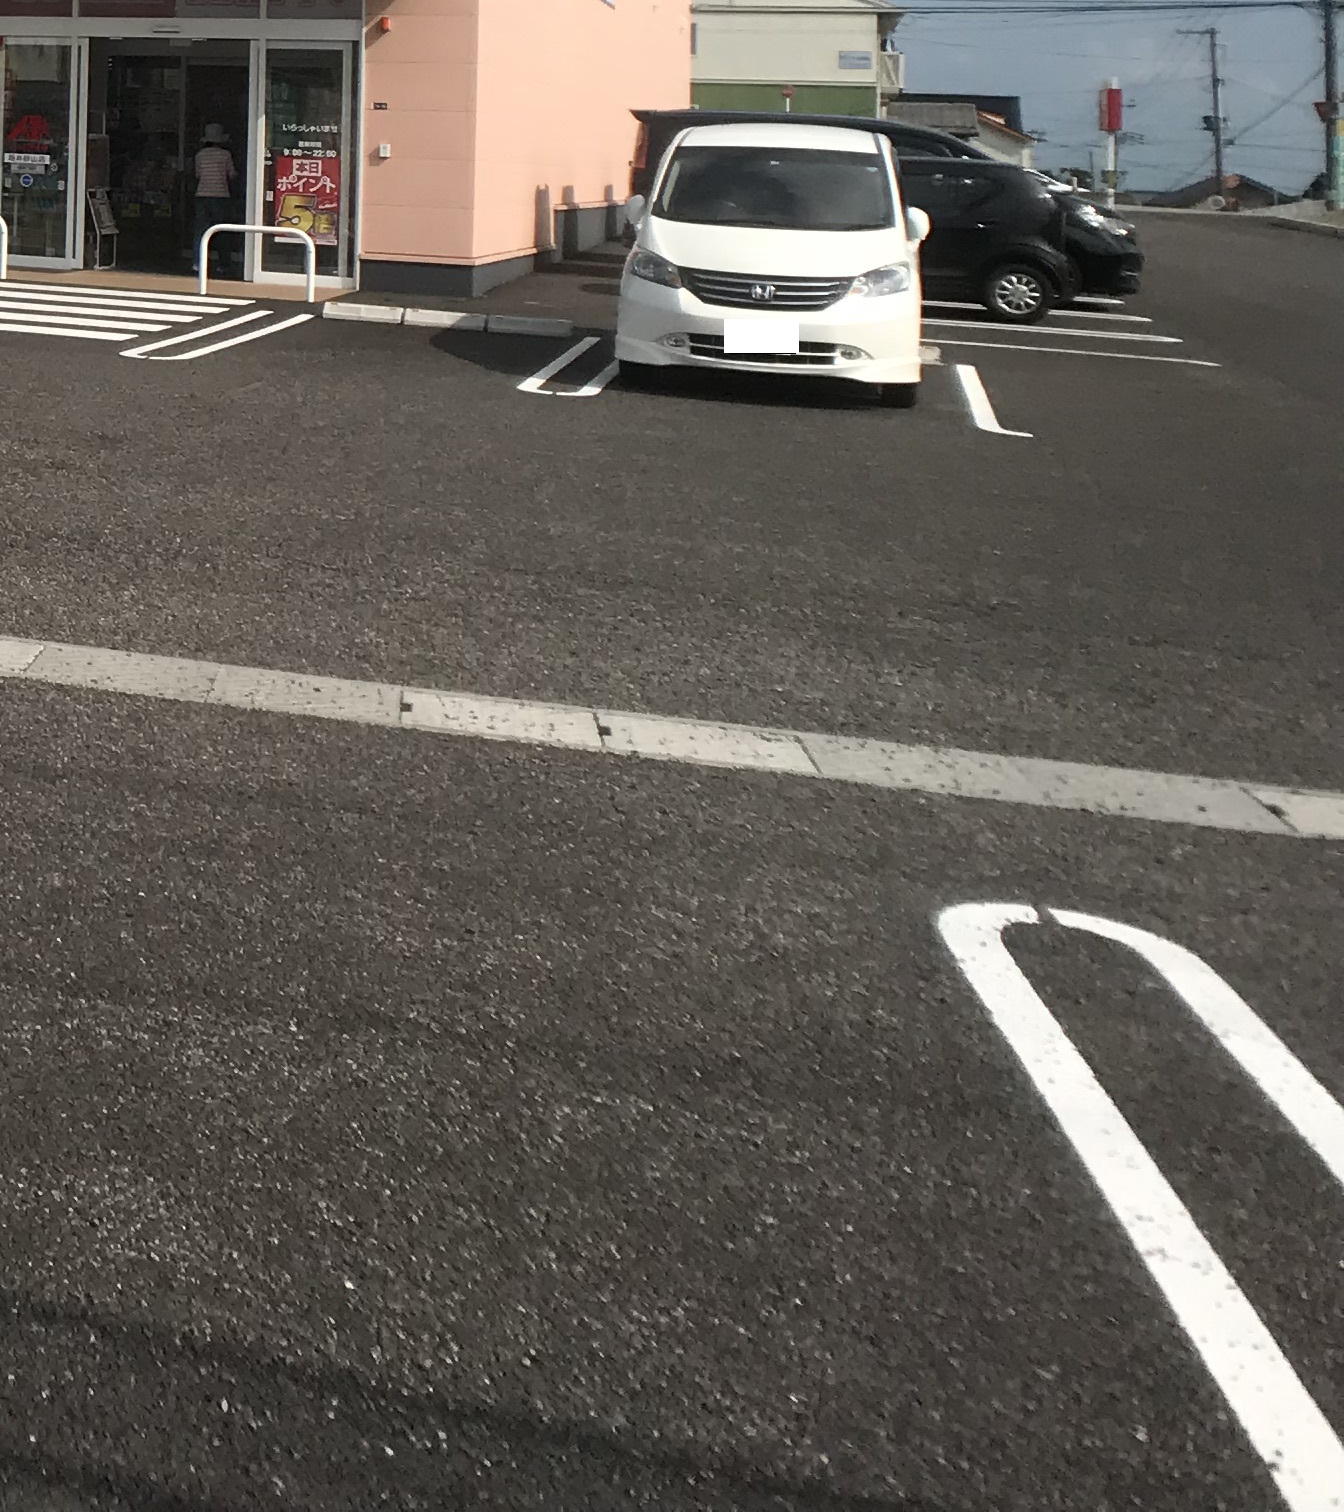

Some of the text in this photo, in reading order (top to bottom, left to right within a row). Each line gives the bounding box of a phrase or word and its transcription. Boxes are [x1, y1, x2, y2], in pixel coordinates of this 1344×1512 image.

[295, 160, 320, 175] 本日
[276, 174, 336, 194] ポイント
